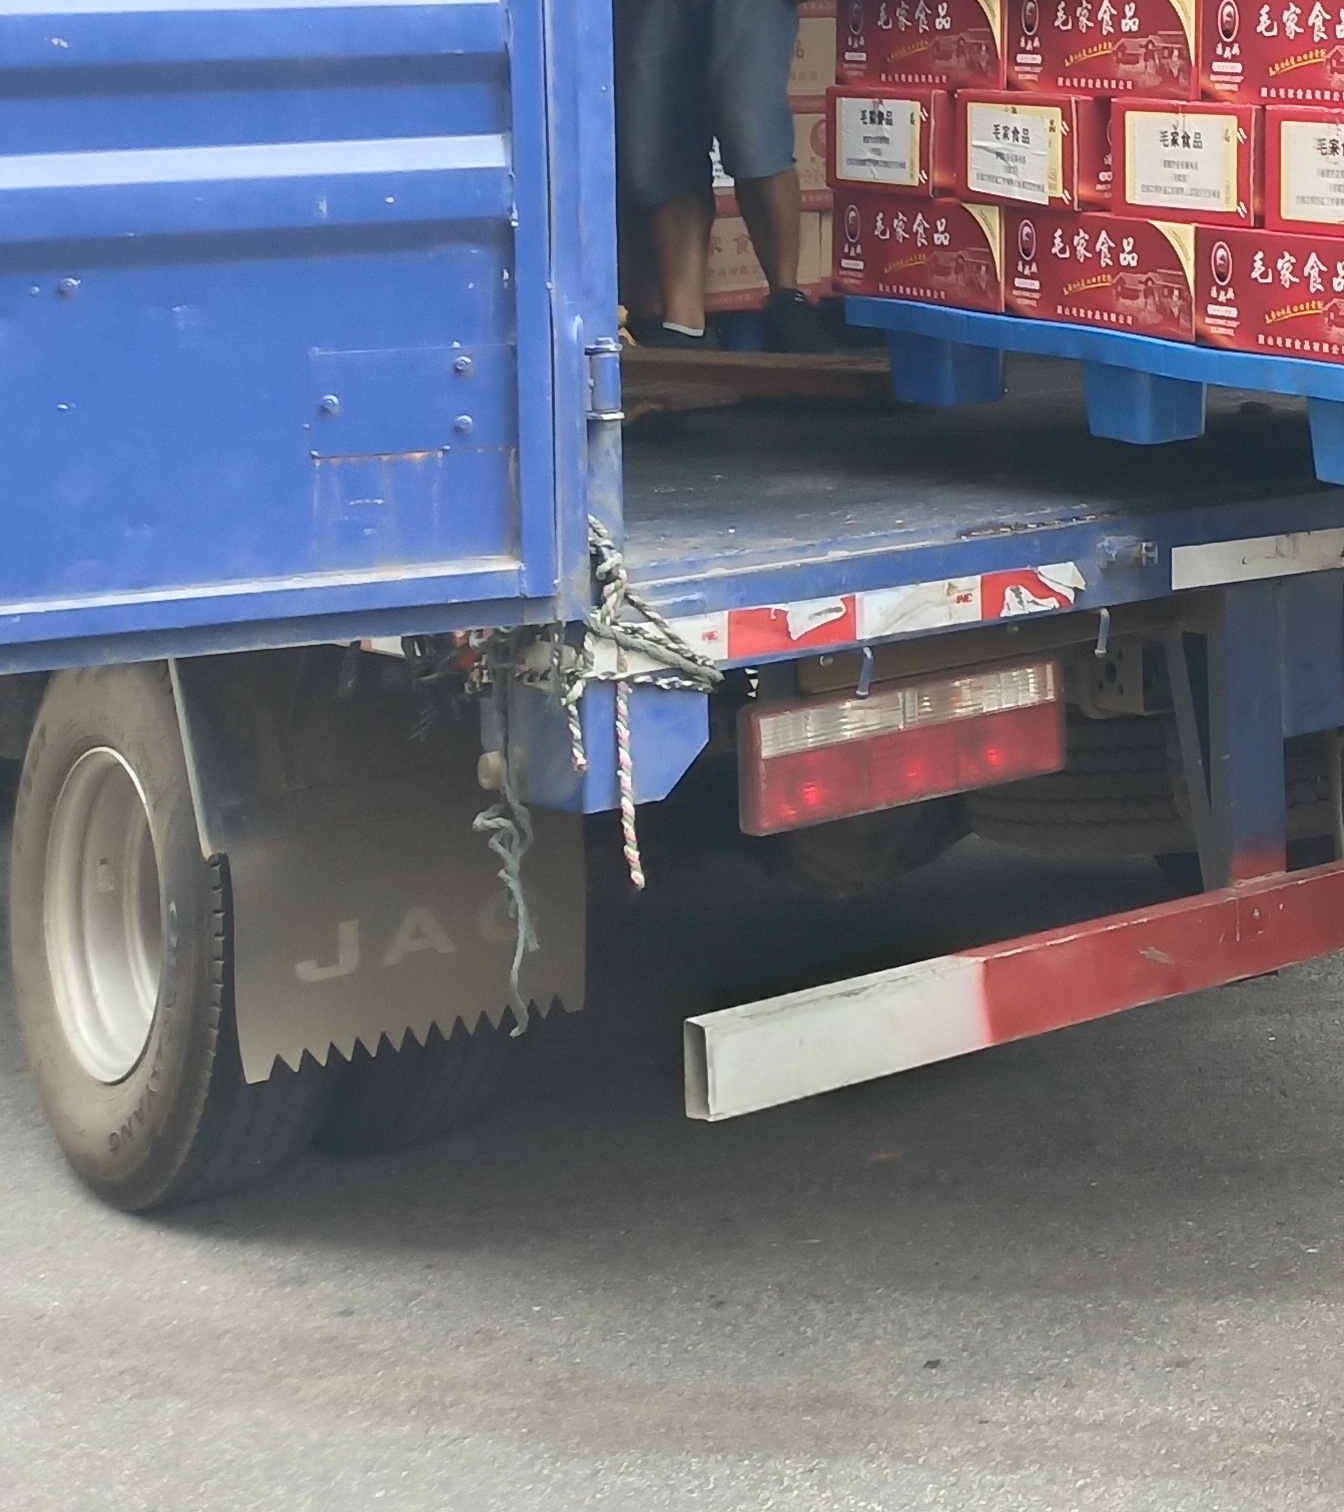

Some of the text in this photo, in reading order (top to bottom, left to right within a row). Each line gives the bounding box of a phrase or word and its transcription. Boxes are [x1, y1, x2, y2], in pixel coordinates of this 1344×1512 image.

[876, 0, 952, 34] 毛家食品
[992, 123, 1031, 145] 毛家食品
[1159, 130, 1204, 149] 毛家食品
[873, 211, 950, 248] 毛家食品
[1050, 227, 1139, 269] 毛家食品
